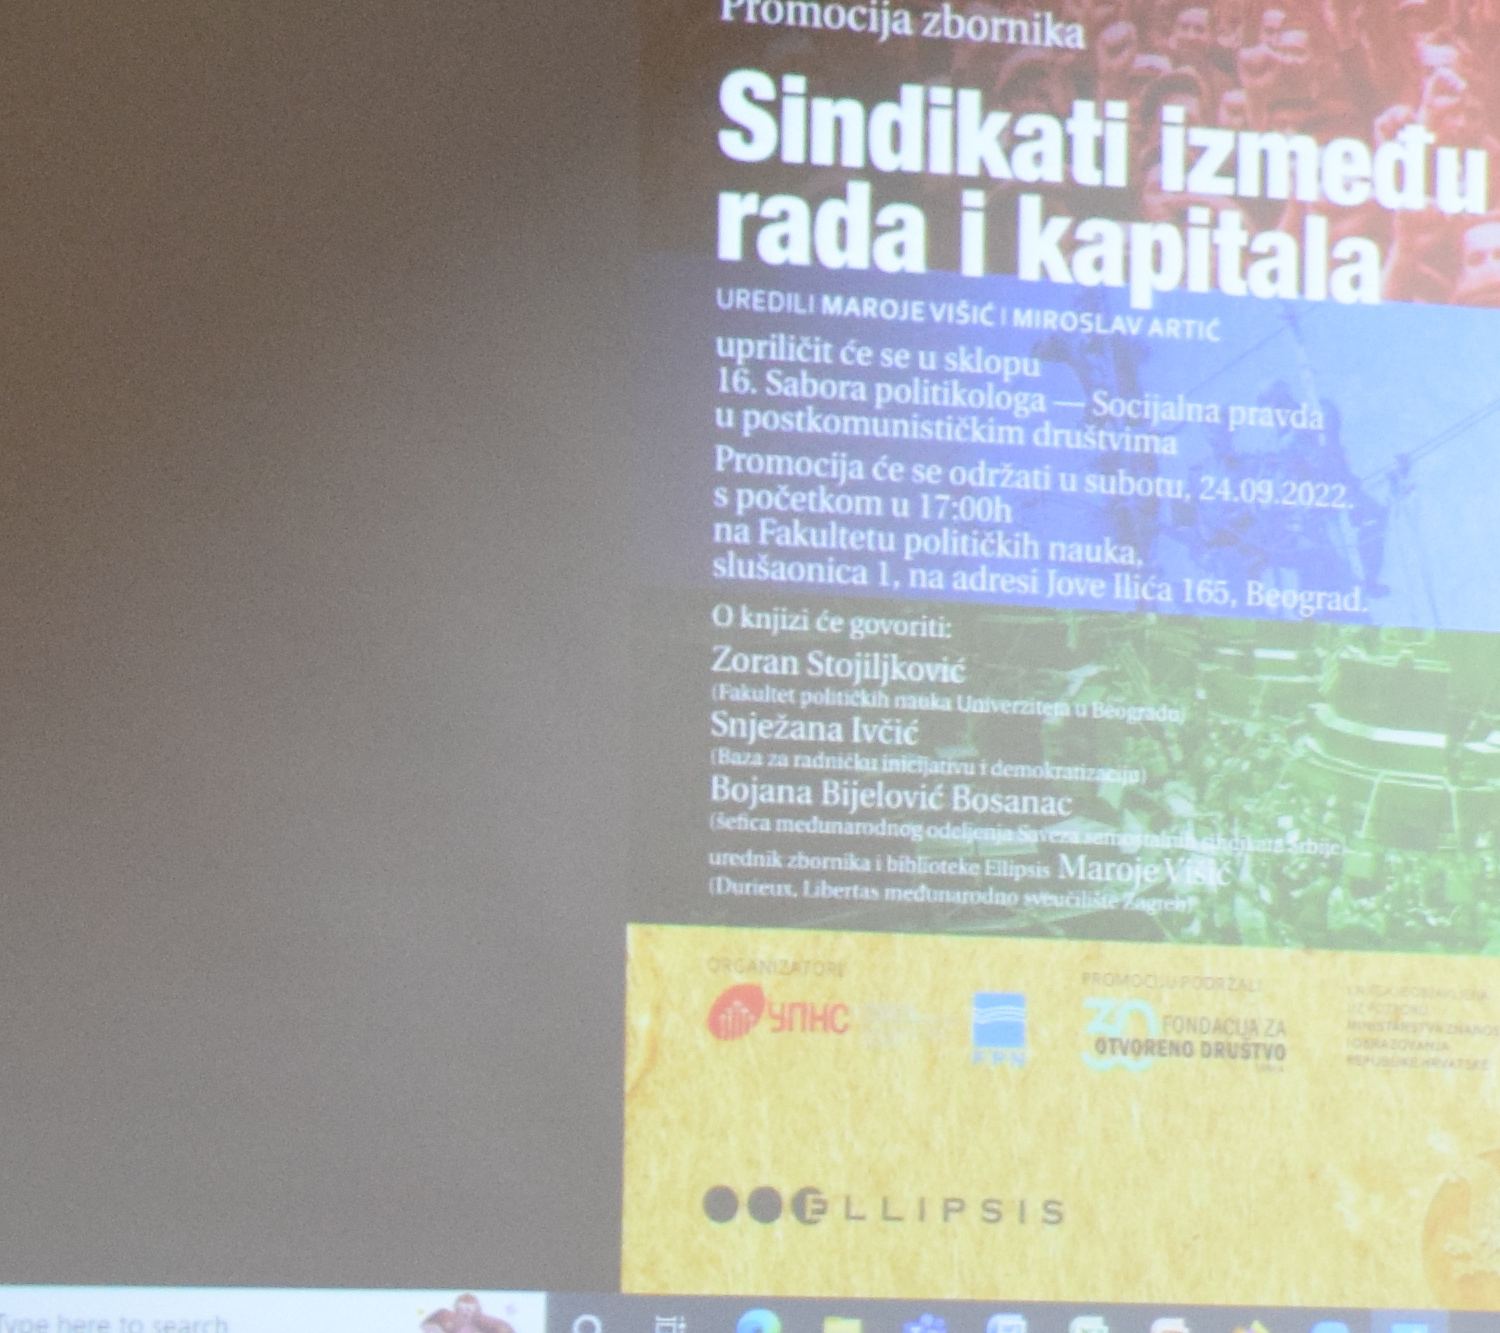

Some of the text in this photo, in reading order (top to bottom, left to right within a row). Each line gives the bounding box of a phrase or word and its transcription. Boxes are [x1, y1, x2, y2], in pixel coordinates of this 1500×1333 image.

[720, 0, 1086, 50] Promocija zbornika
[718, 68, 1489, 215] Sindikati između
[717, 180, 1382, 310] rada i kapitala
[716, 287, 814, 313] UREDILI
[821, 295, 925, 322] MAROJE
[930, 300, 995, 327] VIŠIĆ
[1013, 308, 1144, 335] MIROSLAV
[1147, 317, 1221, 342] ARTIĆ
[715, 333, 1041, 382] upriličit će se u sklopu
[718, 366, 1325, 431] 16. Sabora politikologa Socijalna pravda
[715, 405, 1178, 455] u postkomunističkim društvima
[714, 443, 1355, 510] Promocija će se održati u subotu, 24.09.2022.
[713, 484, 1013, 523] s početkom u 17:00h
[713, 516, 1144, 567] na Fakultetu političkih nauka,
[712, 551, 1368, 618] slušaonica 1, na adresi Jove Ilića 165, Beograd.
[711, 603, 952, 641] O knjizi će govoriti:
[711, 645, 967, 687] Zoran Stojiljković
[710, 709, 919, 746] Snježana Ivčić
[767, 752, 788, 768] za
[711, 773, 1073, 818] Bojana Bijelović Bosanac
[1058, 852, 1160, 890] Maroje
[1094, 1034, 1287, 1061] OTVORENO DRUŠTVO
[1264, 1018, 1287, 1037] ZA
